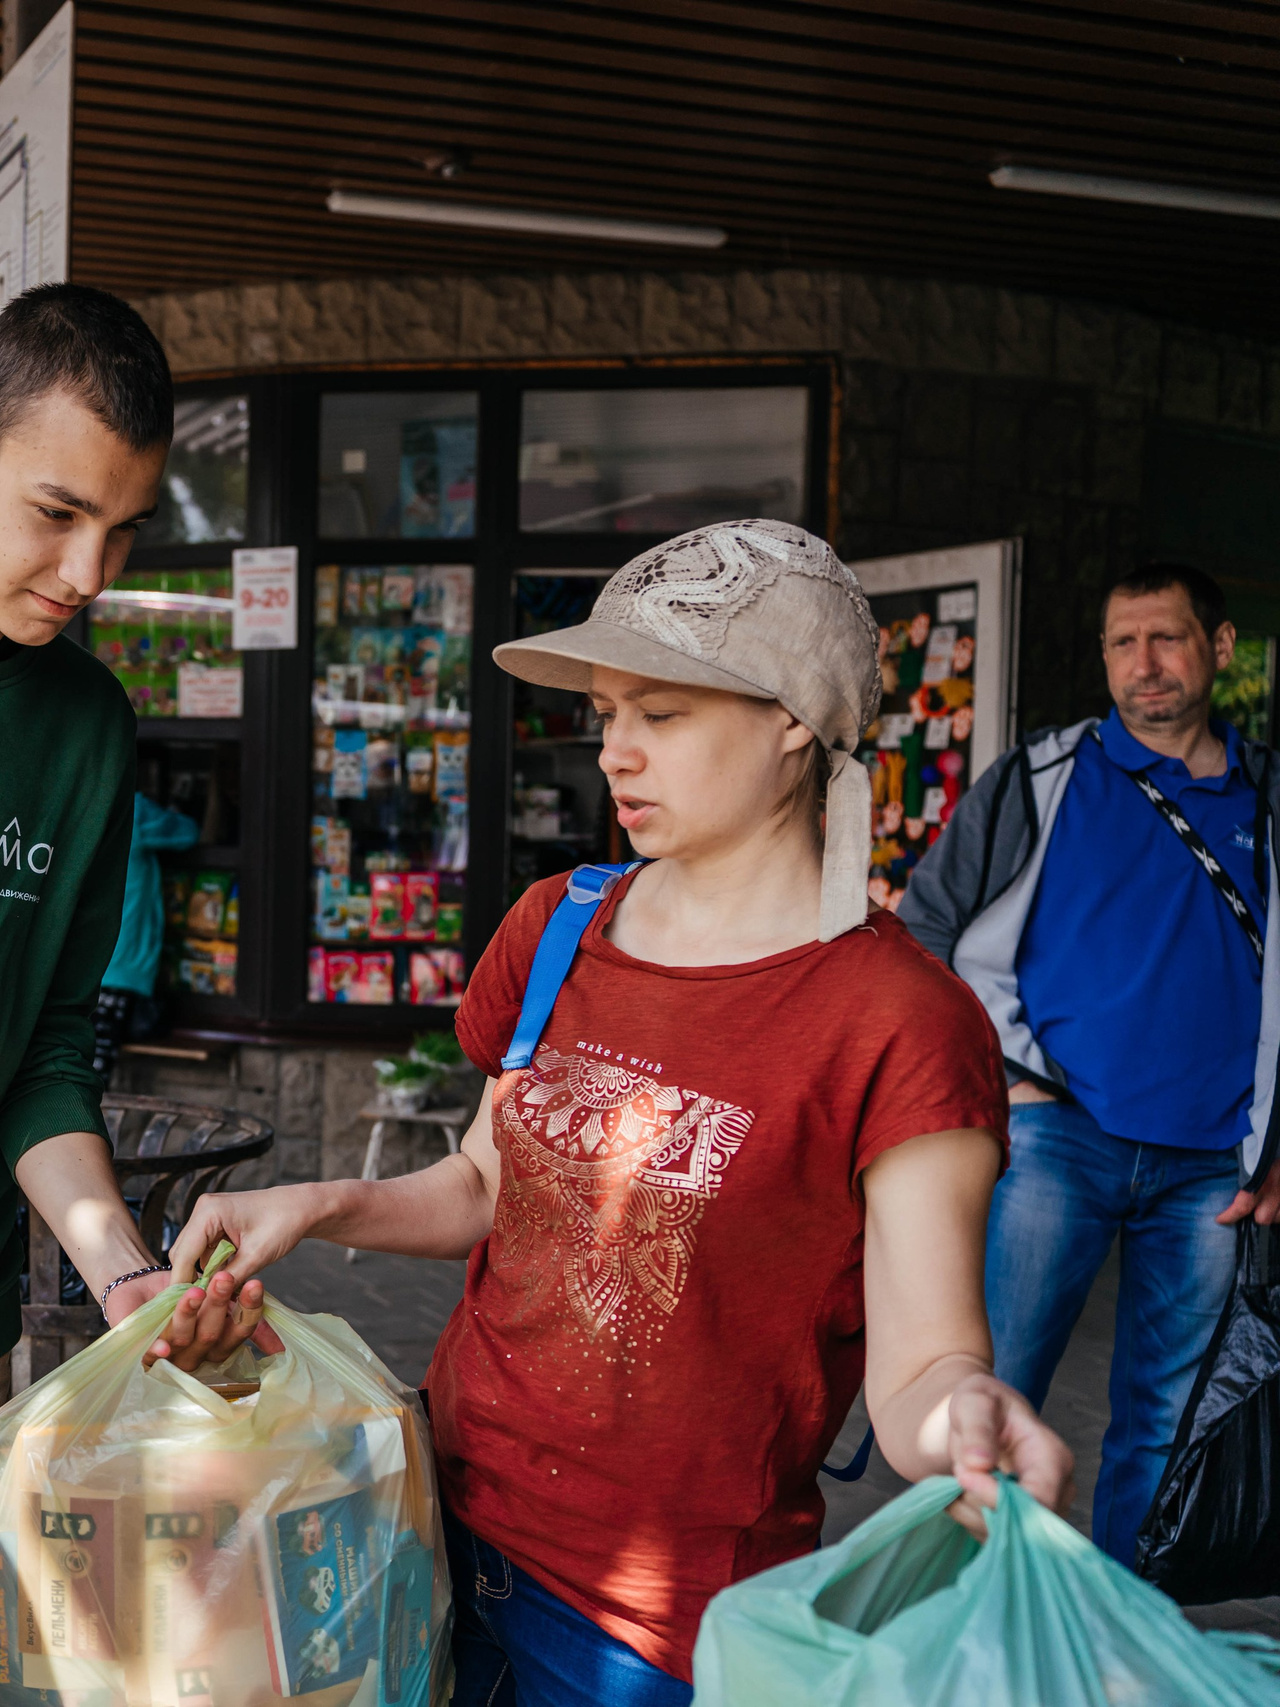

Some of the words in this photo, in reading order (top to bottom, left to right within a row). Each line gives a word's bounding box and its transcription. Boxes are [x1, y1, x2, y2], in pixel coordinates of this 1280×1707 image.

[240, 587, 290, 611] 9-20
[576, 1040, 612, 1057] make
[615, 1052, 624, 1062] a
[629, 1057, 663, 1075] wish
[345, 1545, 362, 1621] МАШИА
[51, 1579, 65, 1648] ПЕЛЬМЕНИ
